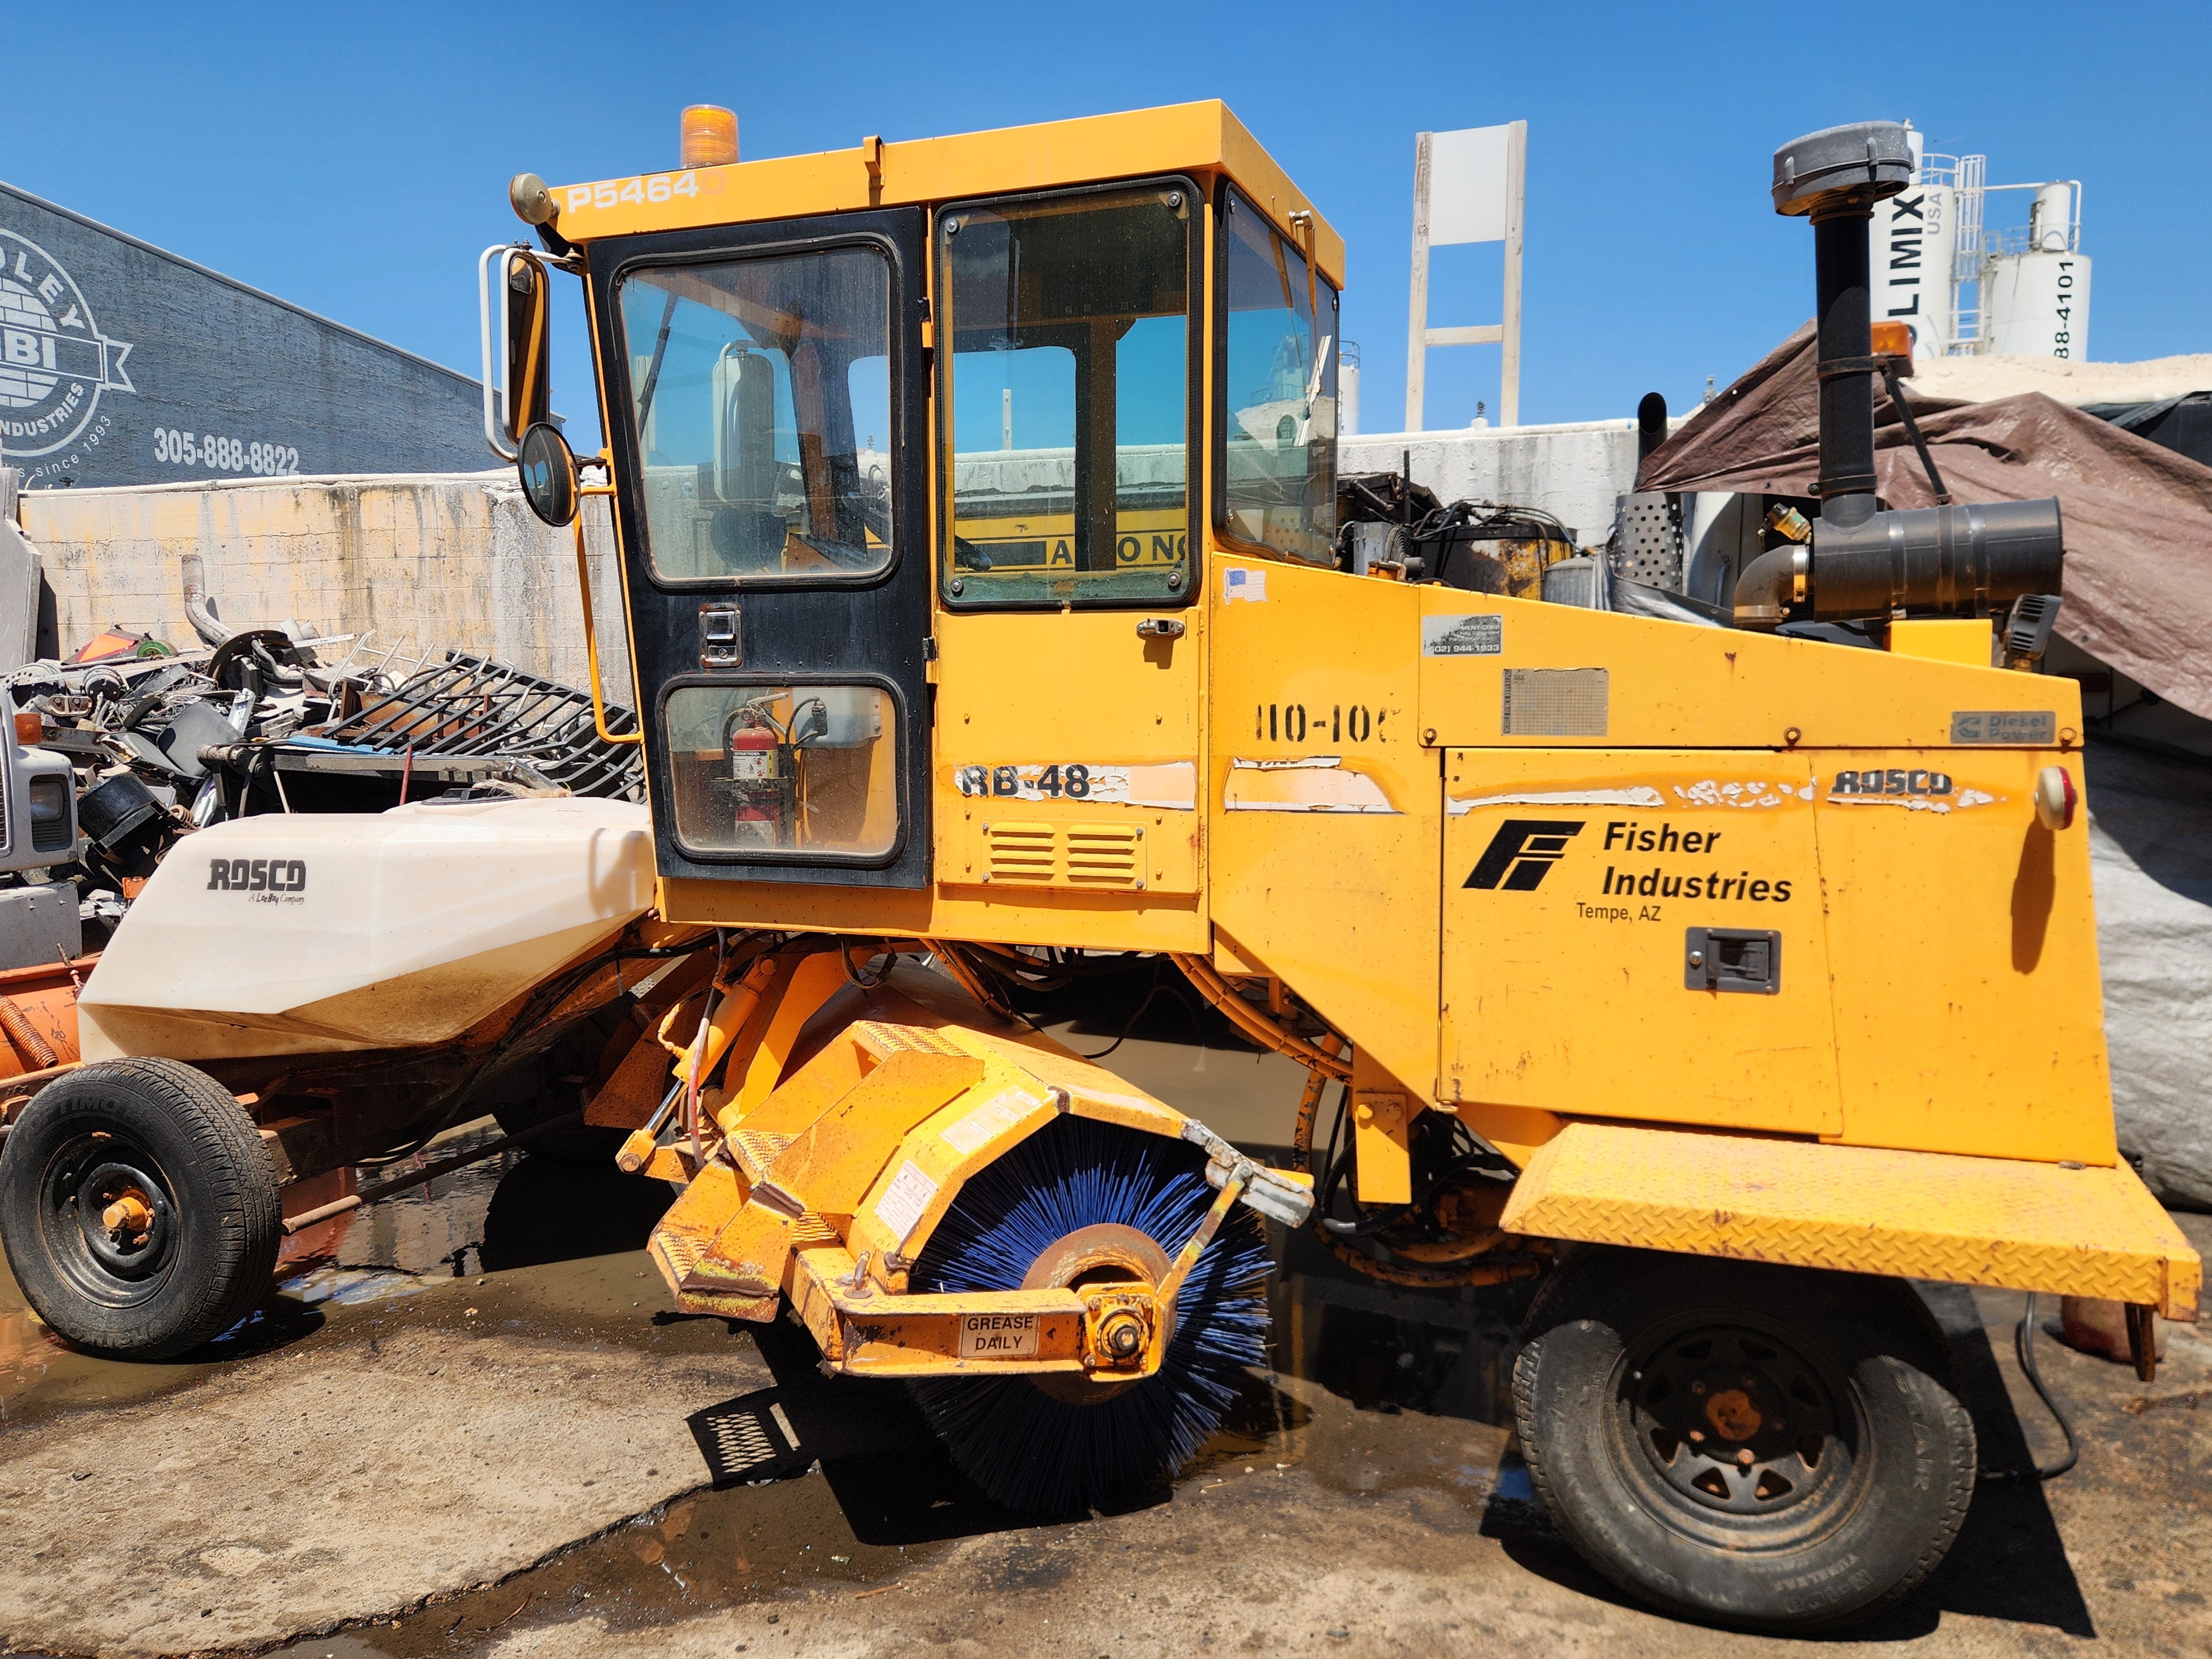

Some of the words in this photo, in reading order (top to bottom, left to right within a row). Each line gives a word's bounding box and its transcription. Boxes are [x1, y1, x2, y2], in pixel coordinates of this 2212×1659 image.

[1927, 193, 1942, 234] USA
[1887, 193, 1924, 346] LIMIX
[0, 246, 86, 330] LEY
[0, 328, 56, 371] BI
[0, 383, 84, 436] NDUSTRIES
[36, 454, 79, 477] since
[84, 416, 111, 452] 1993
[154, 427, 299, 476] 305-888-8822
[1989, 714, 2047, 727] Diesel
[1989, 728, 2047, 740] Power
[962, 764, 1090, 799] RB-48
[1831, 769, 1953, 796] ROSCO
[1603, 821, 1721, 854] Fisher
[206, 859, 306, 891] ROSCO
[1601, 866, 1792, 902] Industries
[248, 894, 255, 902] A
[280, 894, 305, 905] Company
[1577, 902, 1633, 923] Tempe,
[1639, 905, 1661, 922] AZ
[967, 1316, 1034, 1331] GREASE
[975, 1335, 1023, 1350] DAILY
